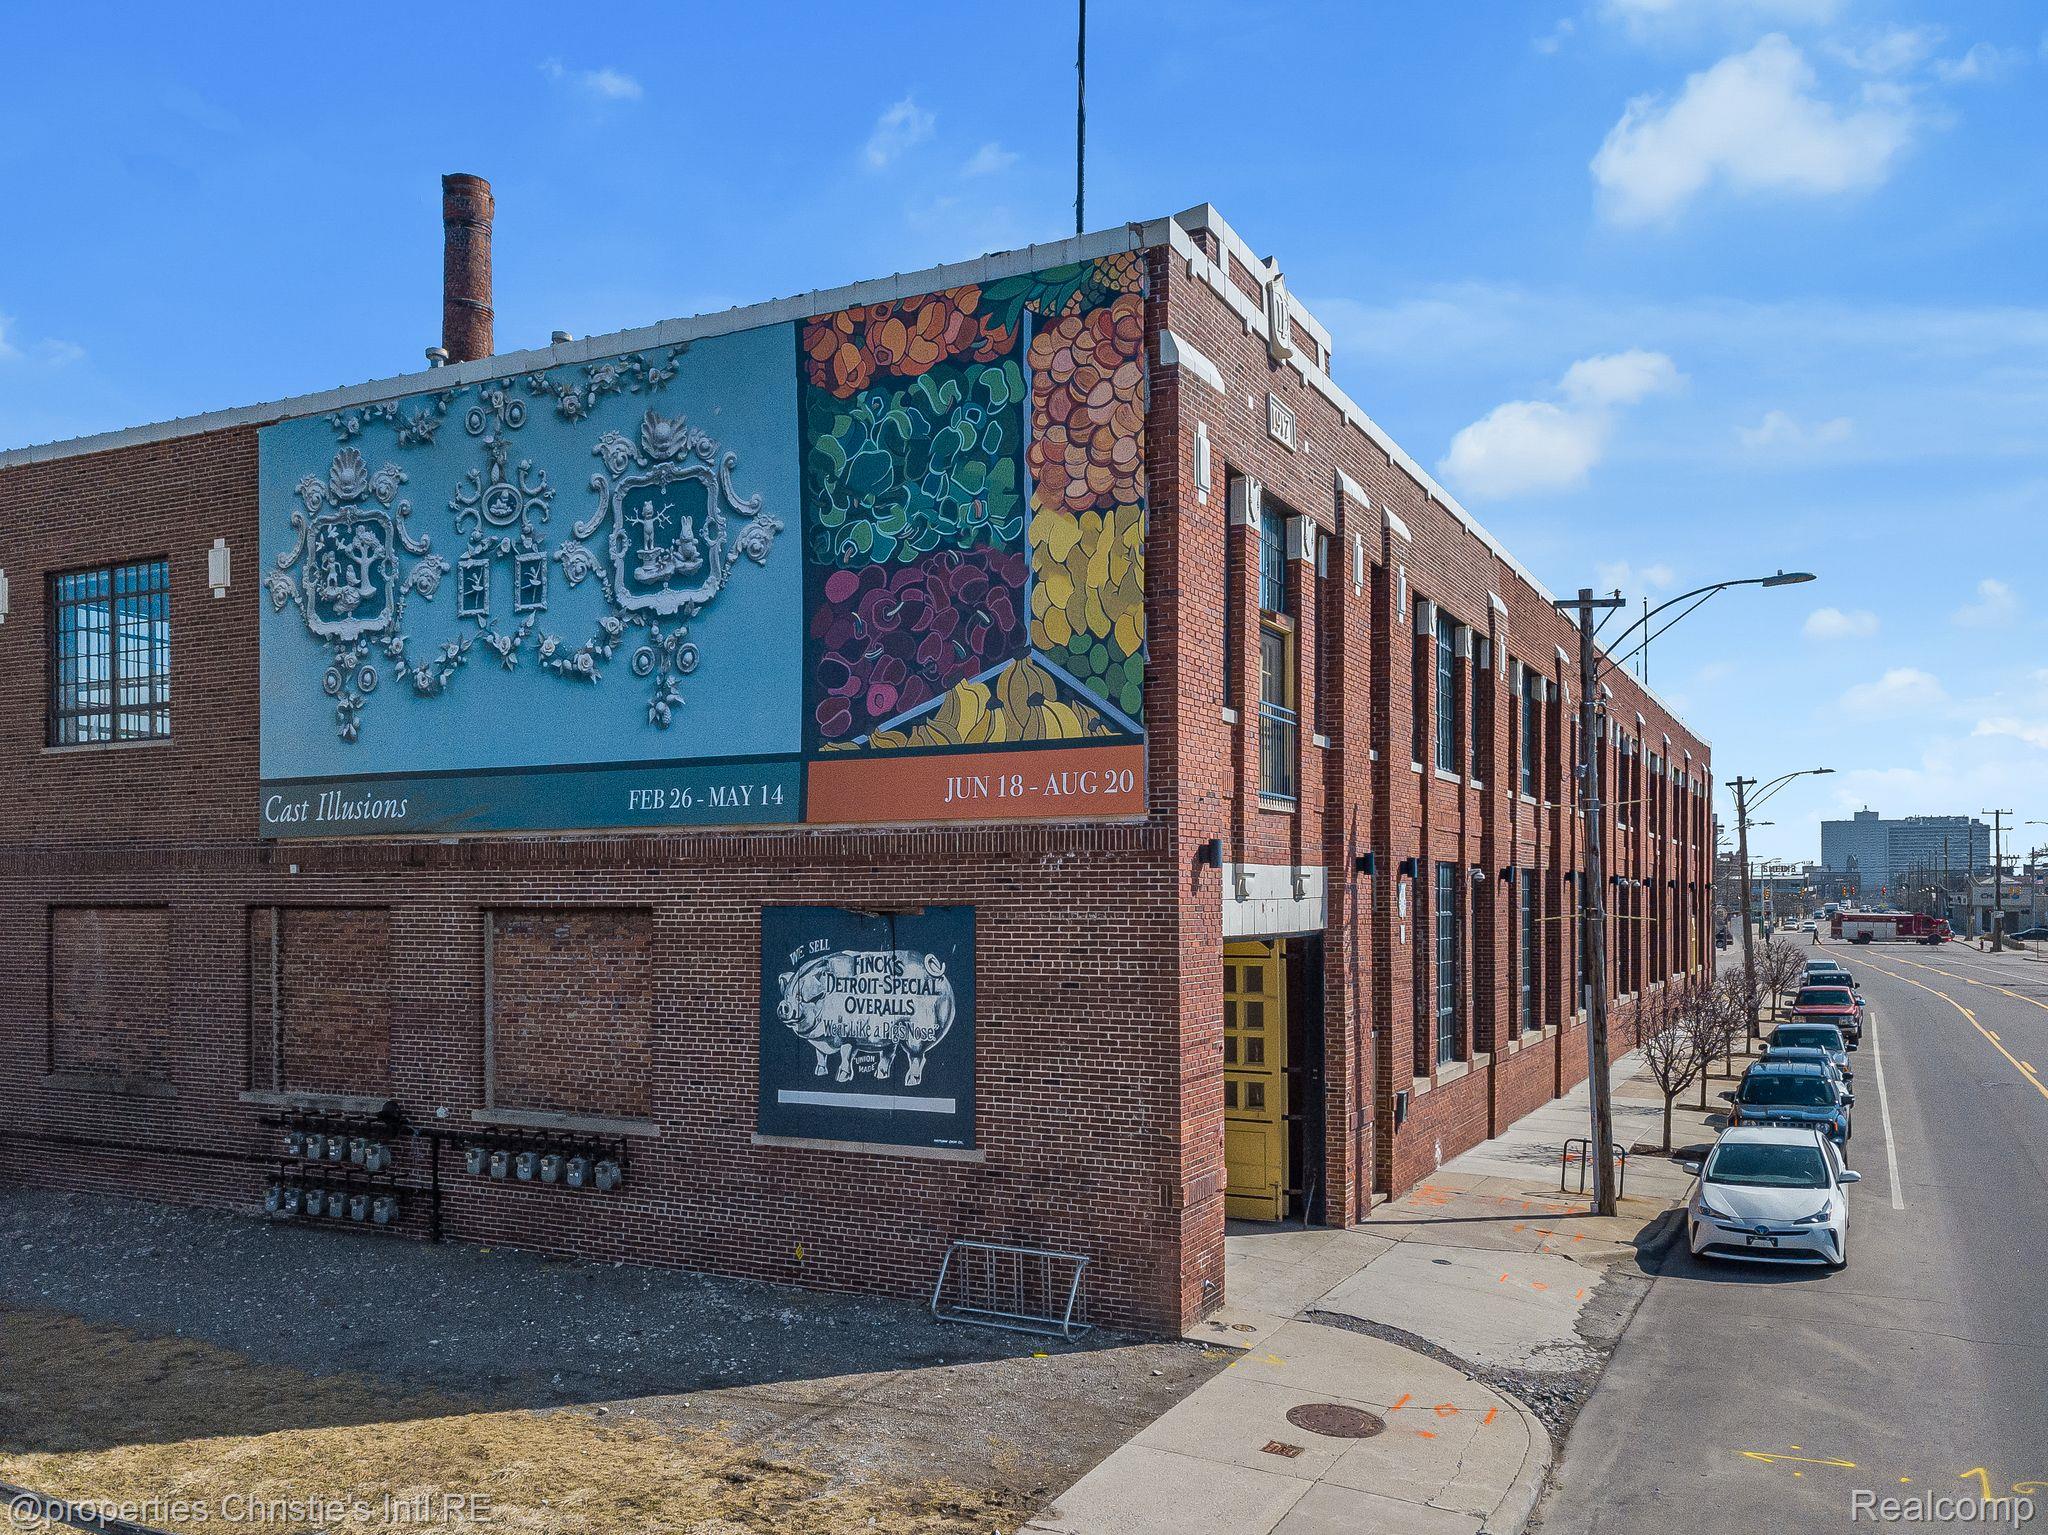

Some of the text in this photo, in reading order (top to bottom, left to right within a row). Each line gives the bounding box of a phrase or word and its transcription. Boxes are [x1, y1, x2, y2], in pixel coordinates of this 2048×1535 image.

[628, 788, 665, 811] FEB
[668, 787, 693, 809] 26
[708, 785, 752, 807] MAY
[759, 783, 784, 807] 14
[944, 776, 989, 803] JUN
[998, 774, 1024, 798] 18
[1043, 770, 1098, 796] AUG
[1103, 768, 1135, 794] 20
[264, 790, 408, 824] Cast Illusions
[789, 938, 831, 967] WE SELL
[844, 996, 915, 1017] OVERALLS
[849, 1020, 871, 1038] Like
[874, 1025, 880, 1038] a
